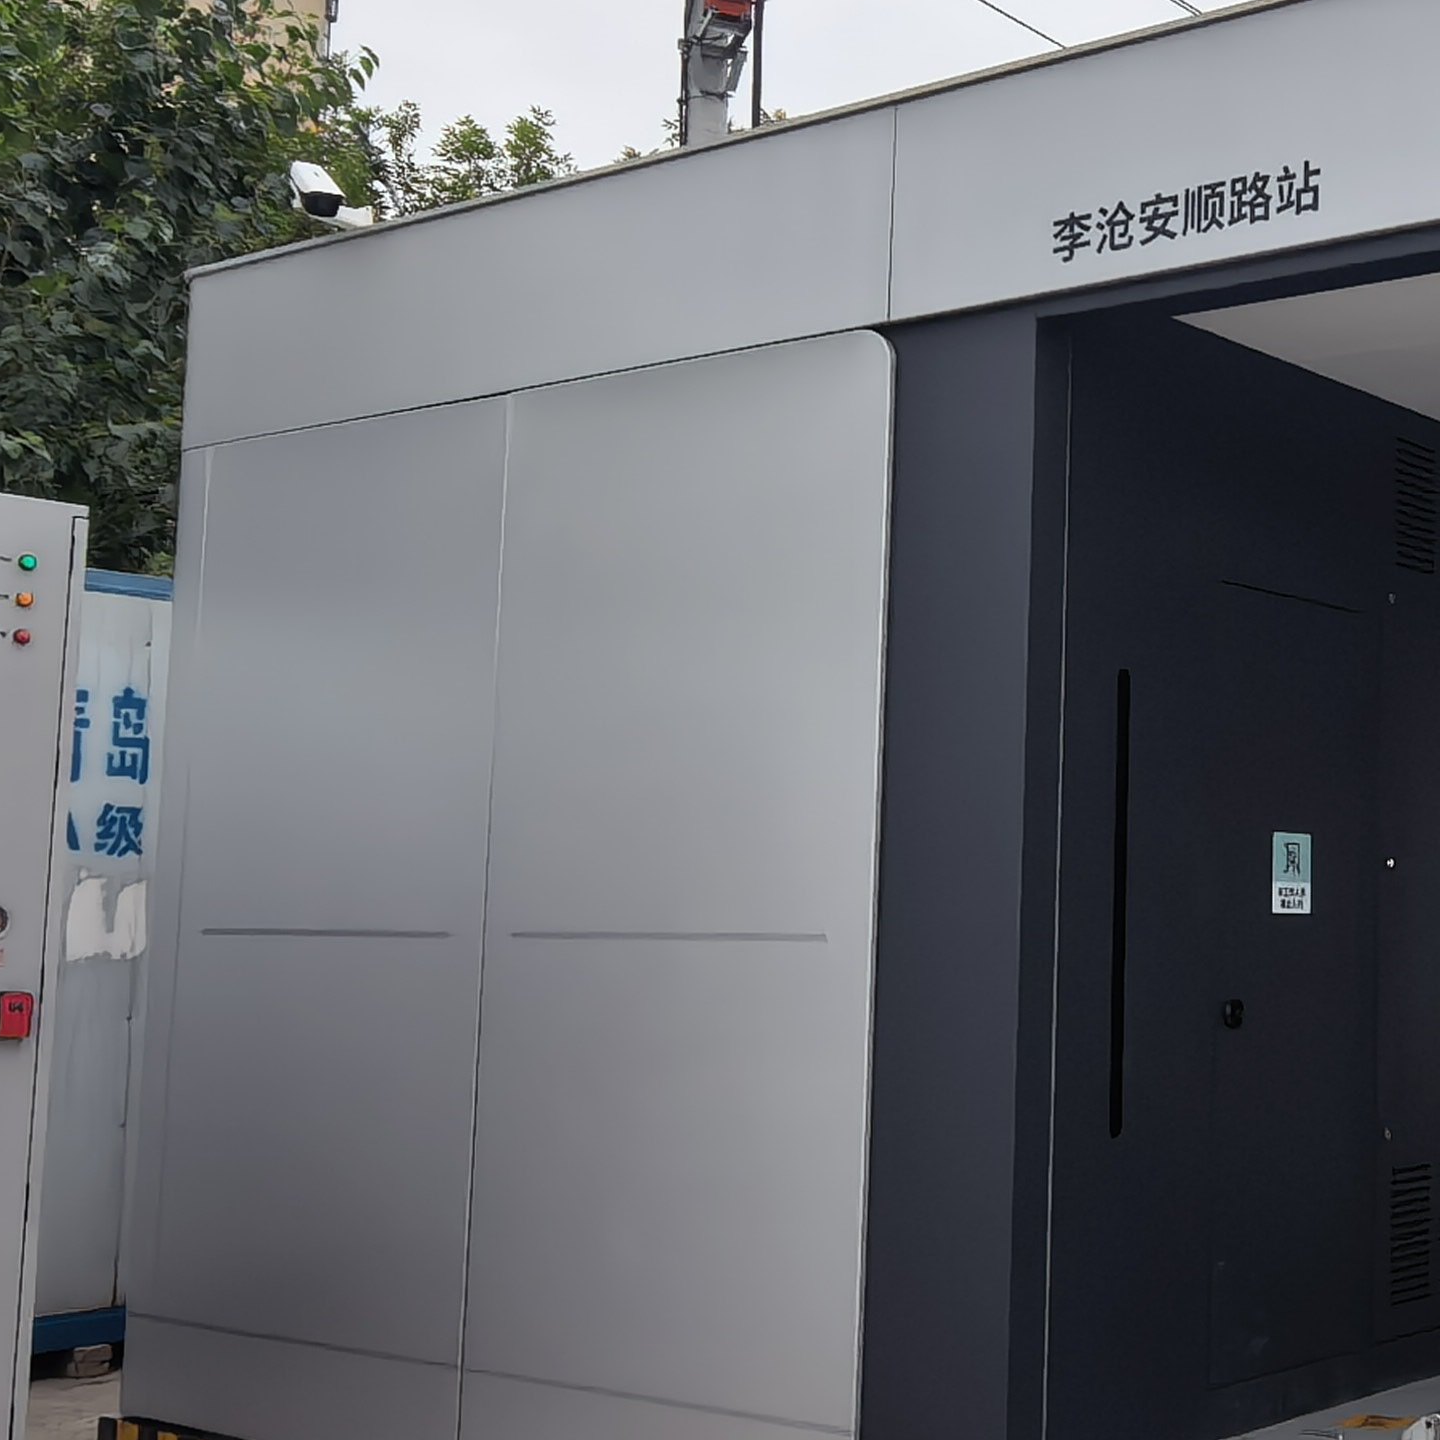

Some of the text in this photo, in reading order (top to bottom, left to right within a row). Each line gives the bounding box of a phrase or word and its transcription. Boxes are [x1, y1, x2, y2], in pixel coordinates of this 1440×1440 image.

[1051, 160, 1321, 262] 李沧安顺路站
